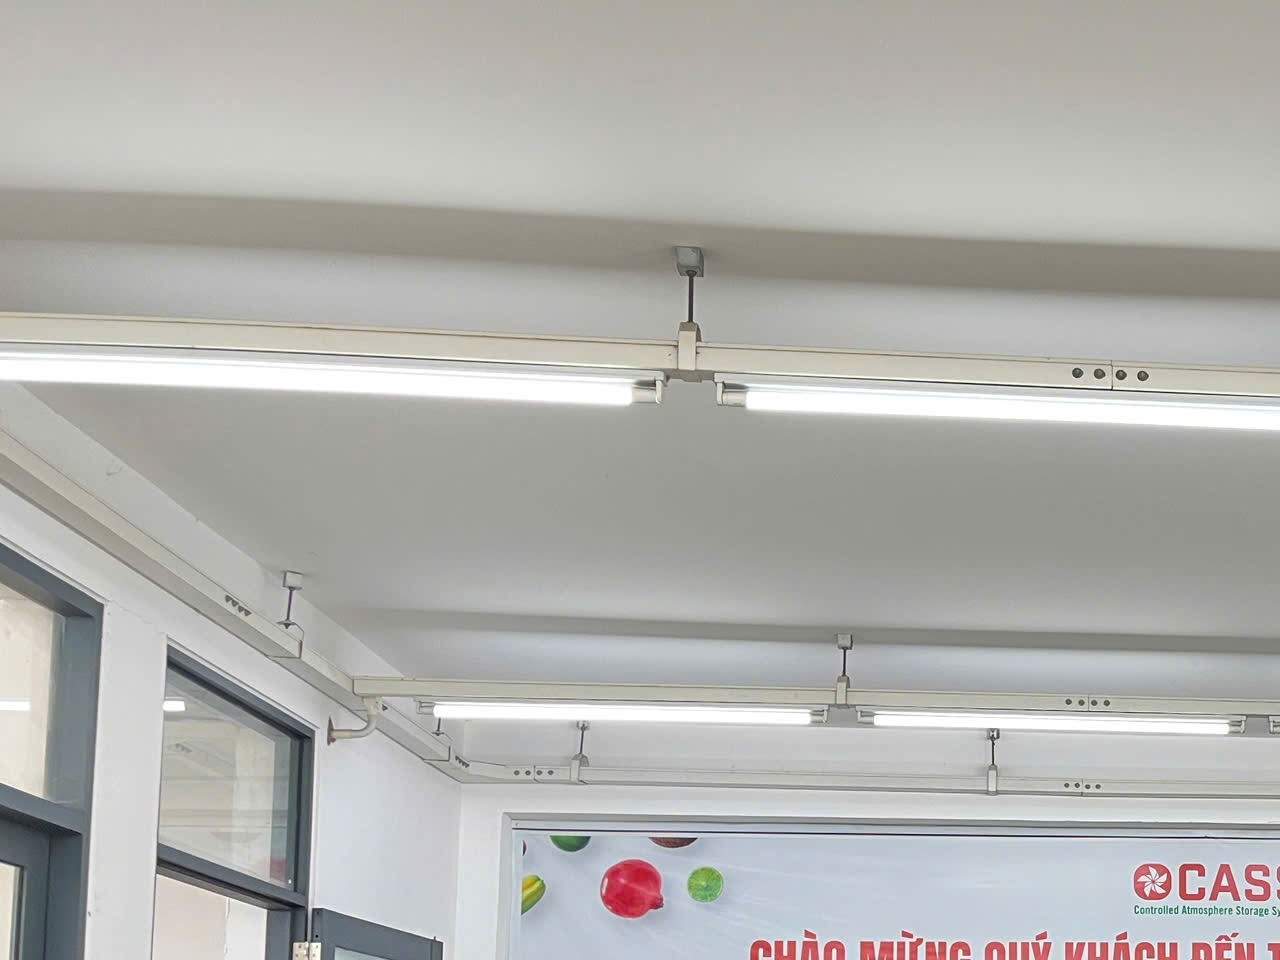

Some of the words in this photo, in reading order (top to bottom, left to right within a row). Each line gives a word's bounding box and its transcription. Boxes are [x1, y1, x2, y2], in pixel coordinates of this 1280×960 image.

[1134, 905, 1179, 915] Controlled
[1181, 905, 1233, 916] Atmosphere
[1235, 905, 1269, 917] Storage
